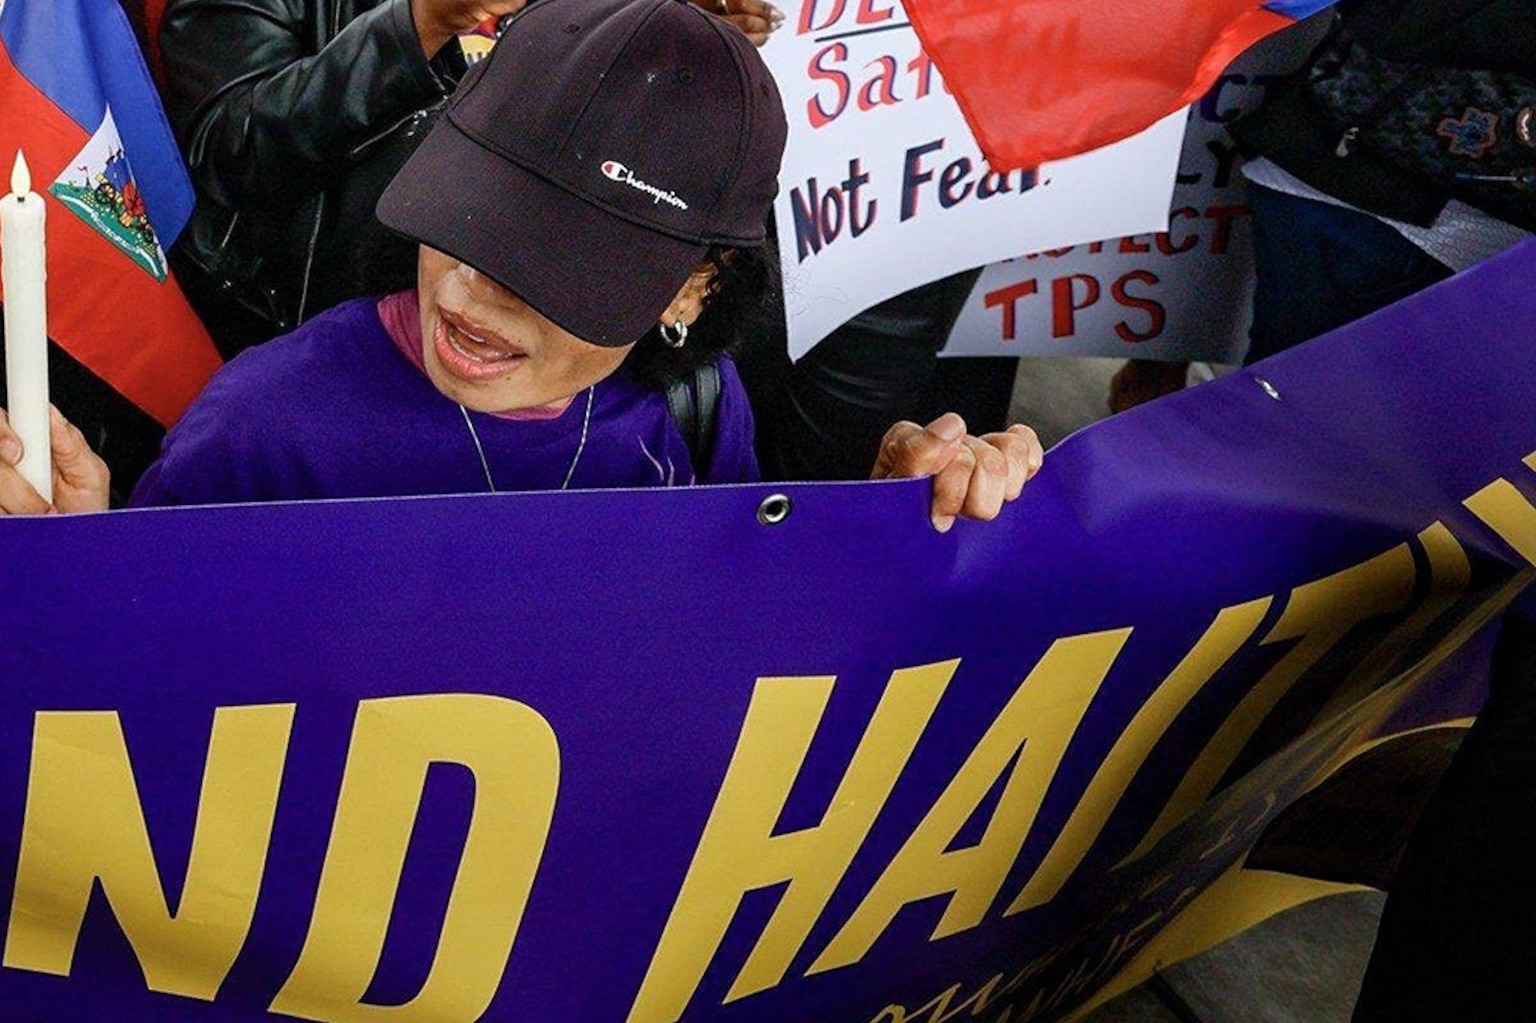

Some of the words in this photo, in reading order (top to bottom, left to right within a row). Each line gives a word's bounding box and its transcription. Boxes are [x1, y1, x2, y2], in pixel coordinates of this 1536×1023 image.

[601, 160, 688, 210] Champion
[790, 158, 878, 264] Not
[985, 270, 1166, 343] TPS
